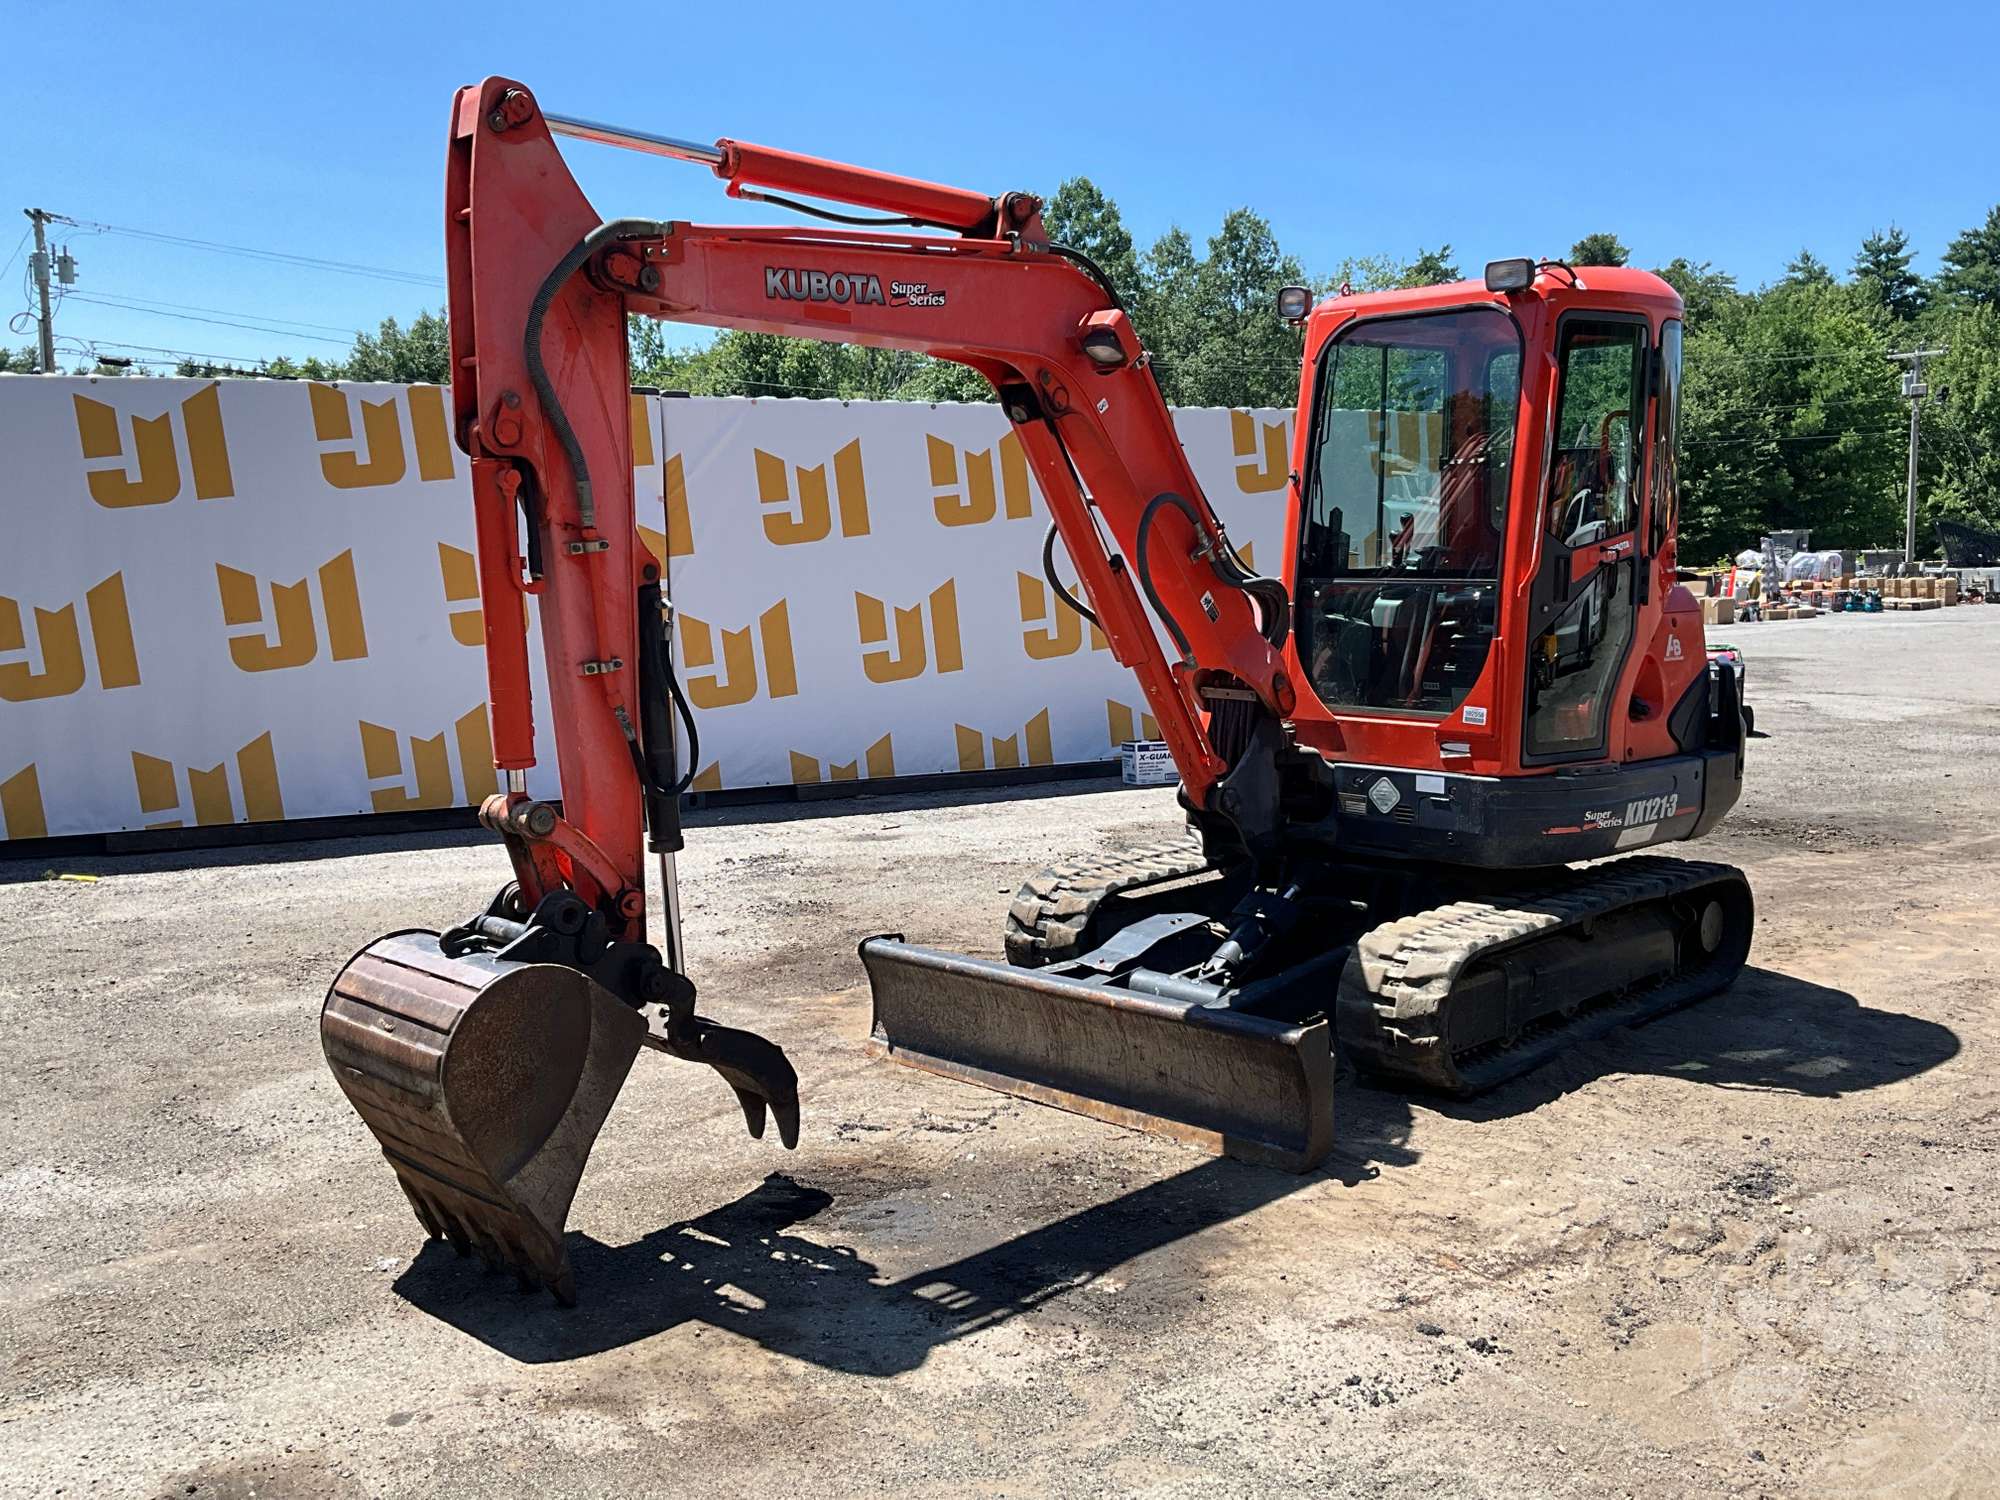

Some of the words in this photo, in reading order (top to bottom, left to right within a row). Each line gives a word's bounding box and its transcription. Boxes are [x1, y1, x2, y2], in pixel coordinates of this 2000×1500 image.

[765, 267, 886, 305] KUBOTA
[890, 282, 927, 297] Super
[909, 293, 945, 306] Series
[1584, 811, 1612, 821] Super
[1624, 794, 1677, 826] KX121-3
[1597, 818, 1622, 828] Series
